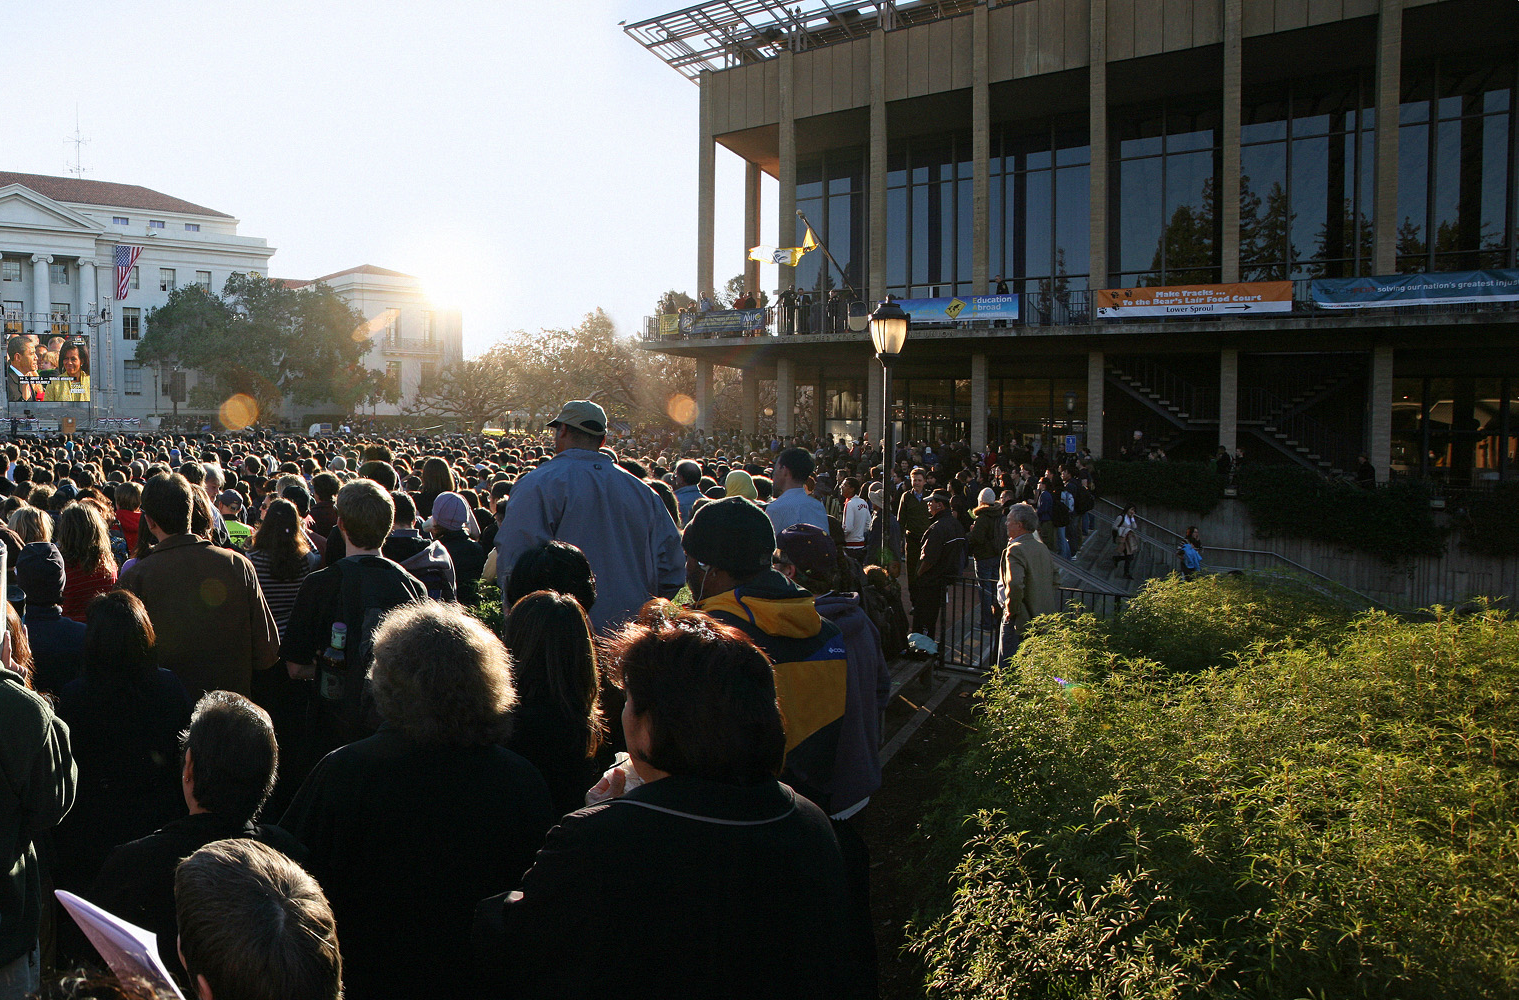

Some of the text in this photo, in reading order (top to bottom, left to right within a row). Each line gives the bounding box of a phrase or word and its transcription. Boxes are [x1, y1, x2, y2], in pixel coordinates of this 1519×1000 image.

[1377, 285, 1405, 293] solving
[1423, 281, 1456, 289] nation's
[1458, 280, 1494, 290] greatest
[1182, 289, 1213, 297] Tracks
[972, 296, 1012, 304] Education
[1153, 297, 1183, 305] Bear's
[1207, 295, 1230, 303] Food
[1232, 294, 1262, 302] Court
[1190, 305, 1214, 313] Sproul
